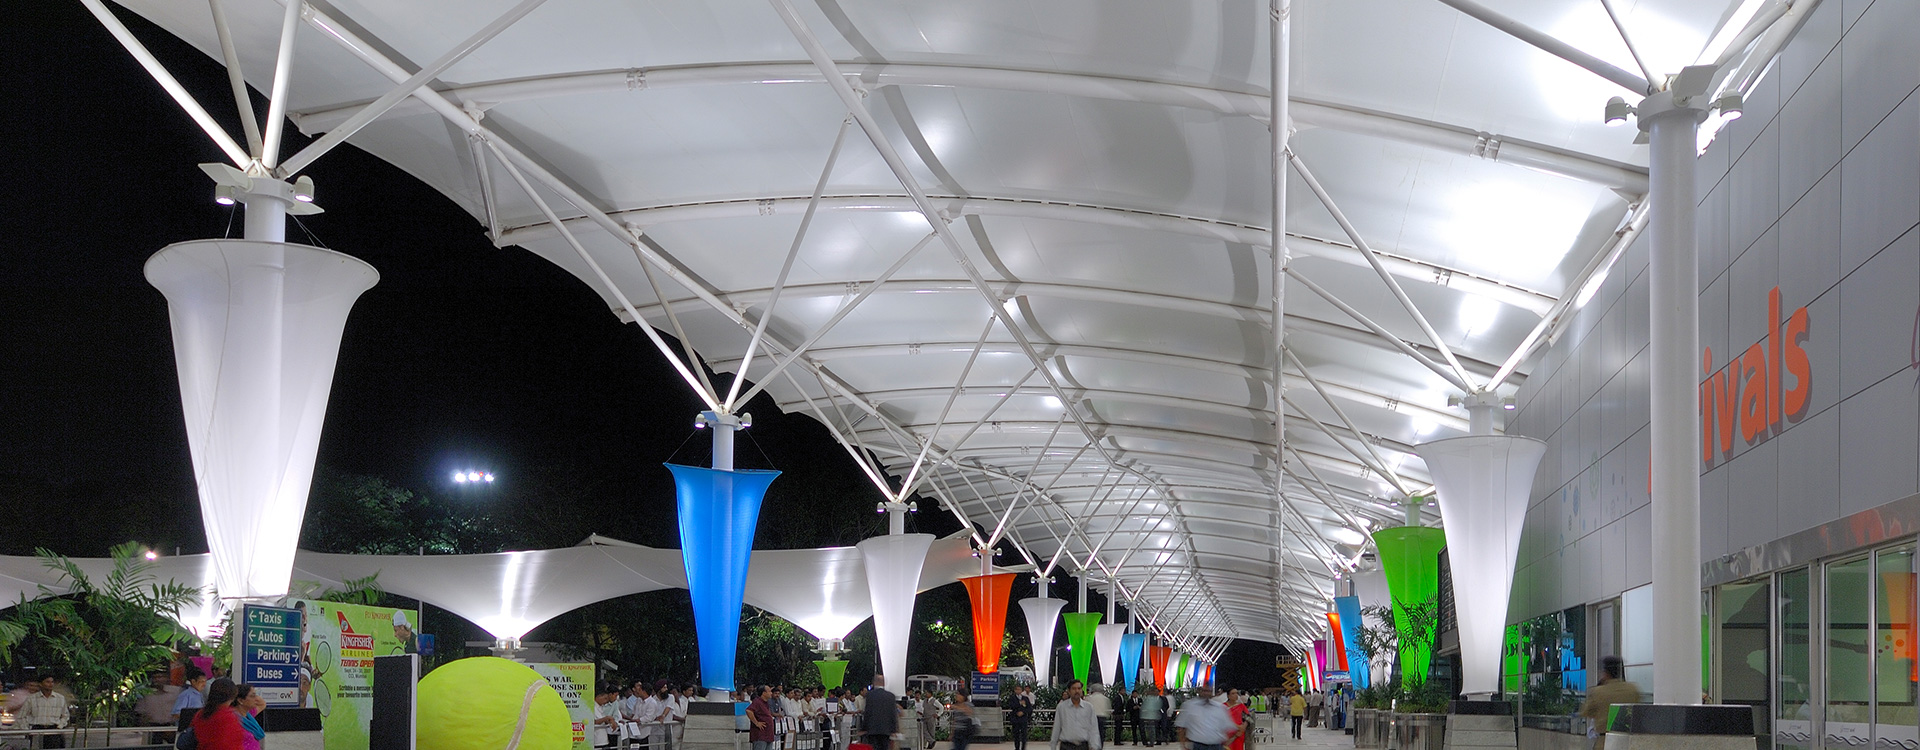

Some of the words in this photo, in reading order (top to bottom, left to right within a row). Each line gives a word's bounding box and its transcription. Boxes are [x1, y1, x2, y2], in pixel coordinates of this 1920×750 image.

[1698, 286, 1810, 463] ivals
[259, 611, 282, 624] Taxis
[258, 630, 284, 643] Autos
[341, 635, 373, 650] KINGFISHER
[257, 648, 291, 664] Parking
[341, 650, 374, 658] AIRLINES
[341, 659, 359, 667] TENNIS
[256, 667, 283, 679] Buses
